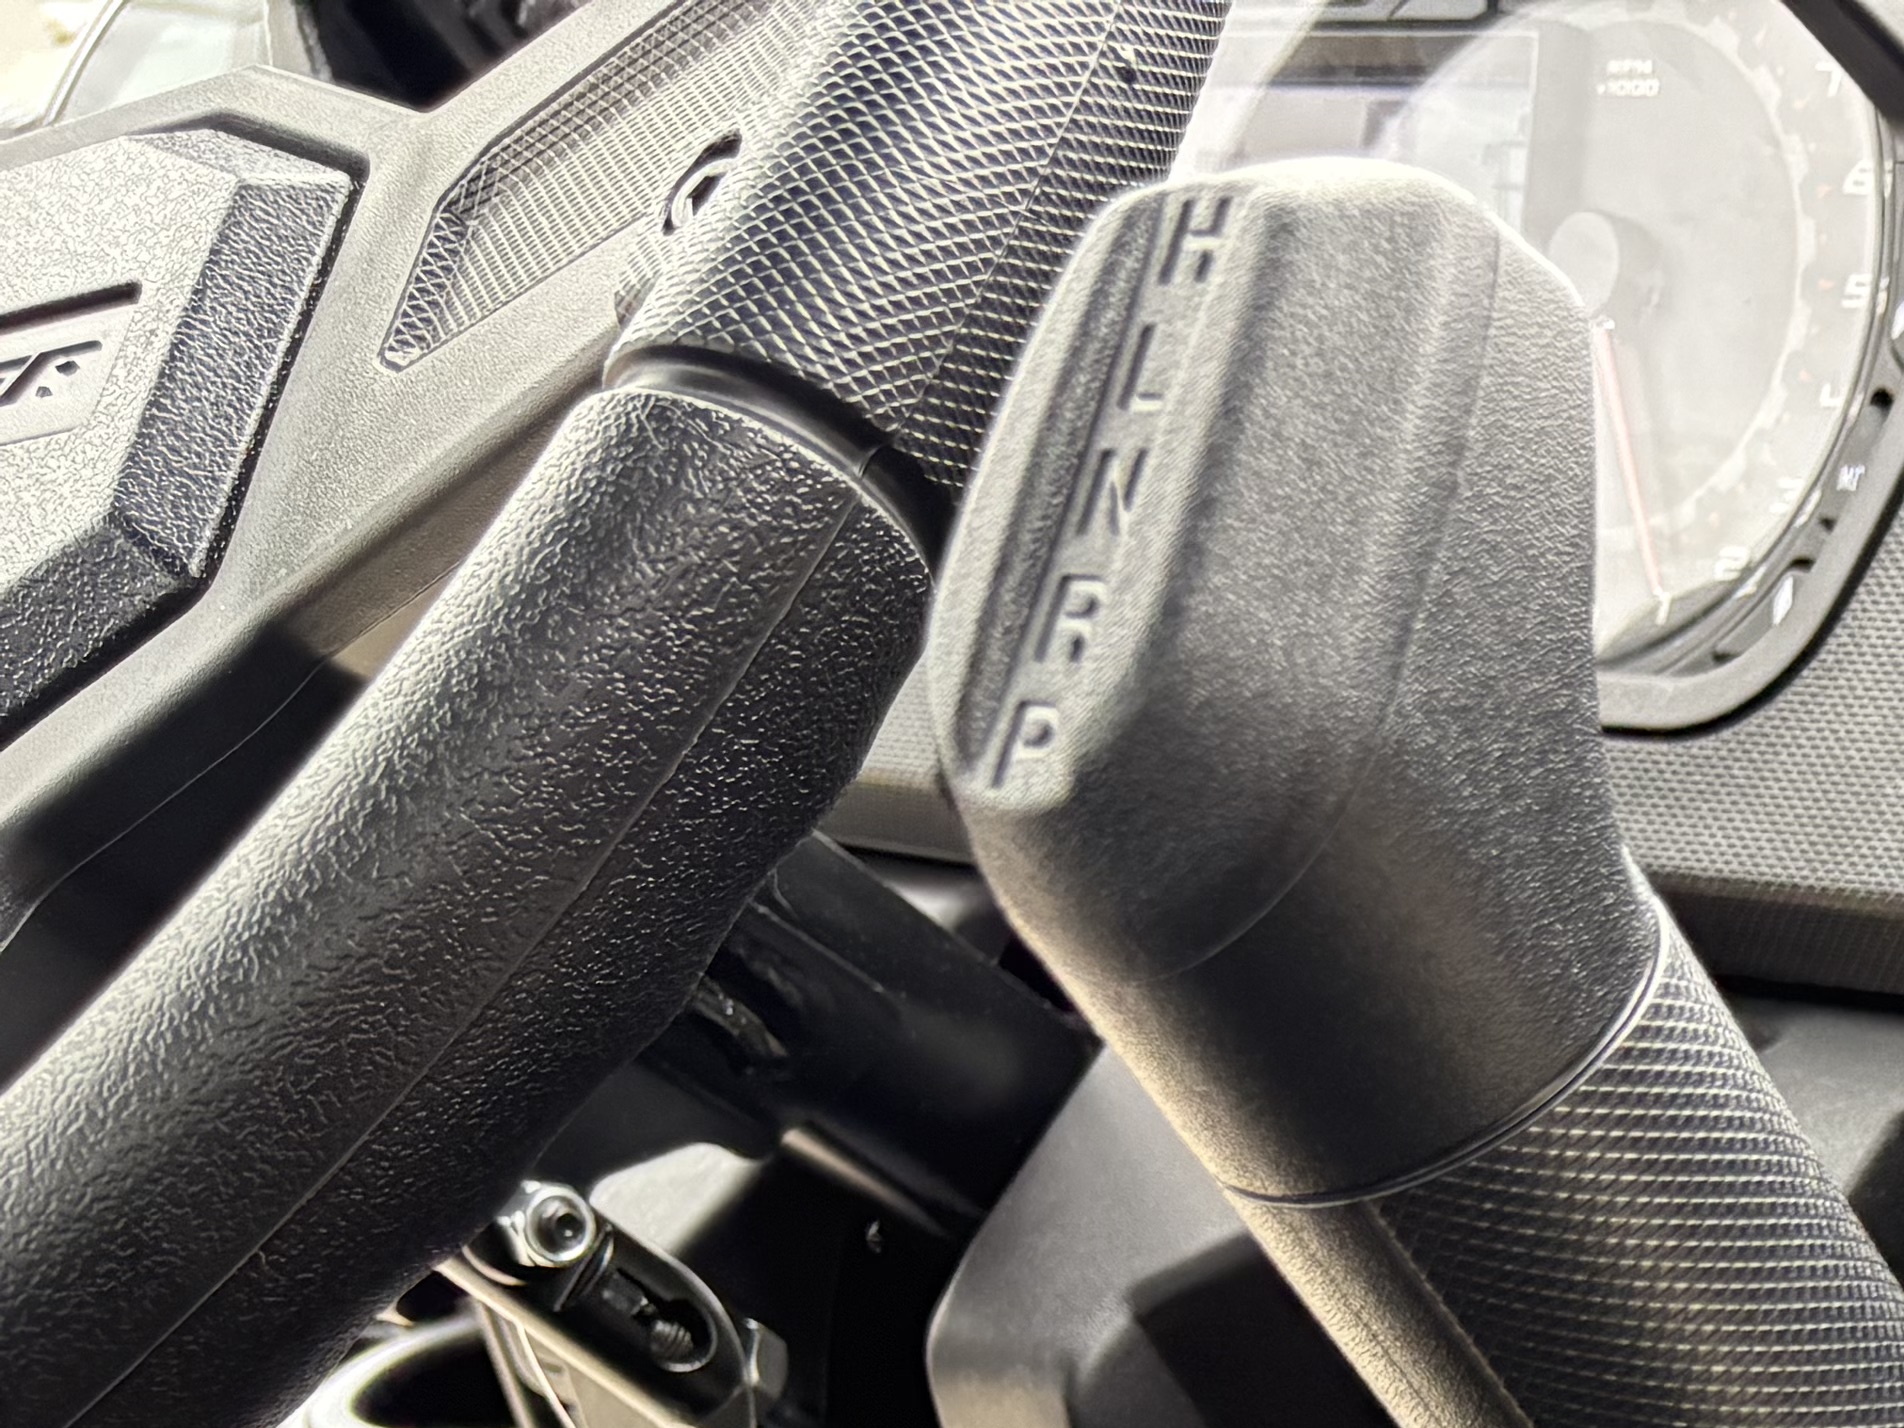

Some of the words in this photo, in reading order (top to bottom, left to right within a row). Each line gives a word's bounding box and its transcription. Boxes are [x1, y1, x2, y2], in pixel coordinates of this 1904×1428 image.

[1815, 61, 1843, 97] 7
[1157, 197, 1232, 286] H
[1841, 273, 1872, 309] 5
[1117, 323, 1163, 411] L
[1076, 447, 1150, 536] N
[1035, 573, 1106, 663] R
[992, 701, 1060, 788] P
